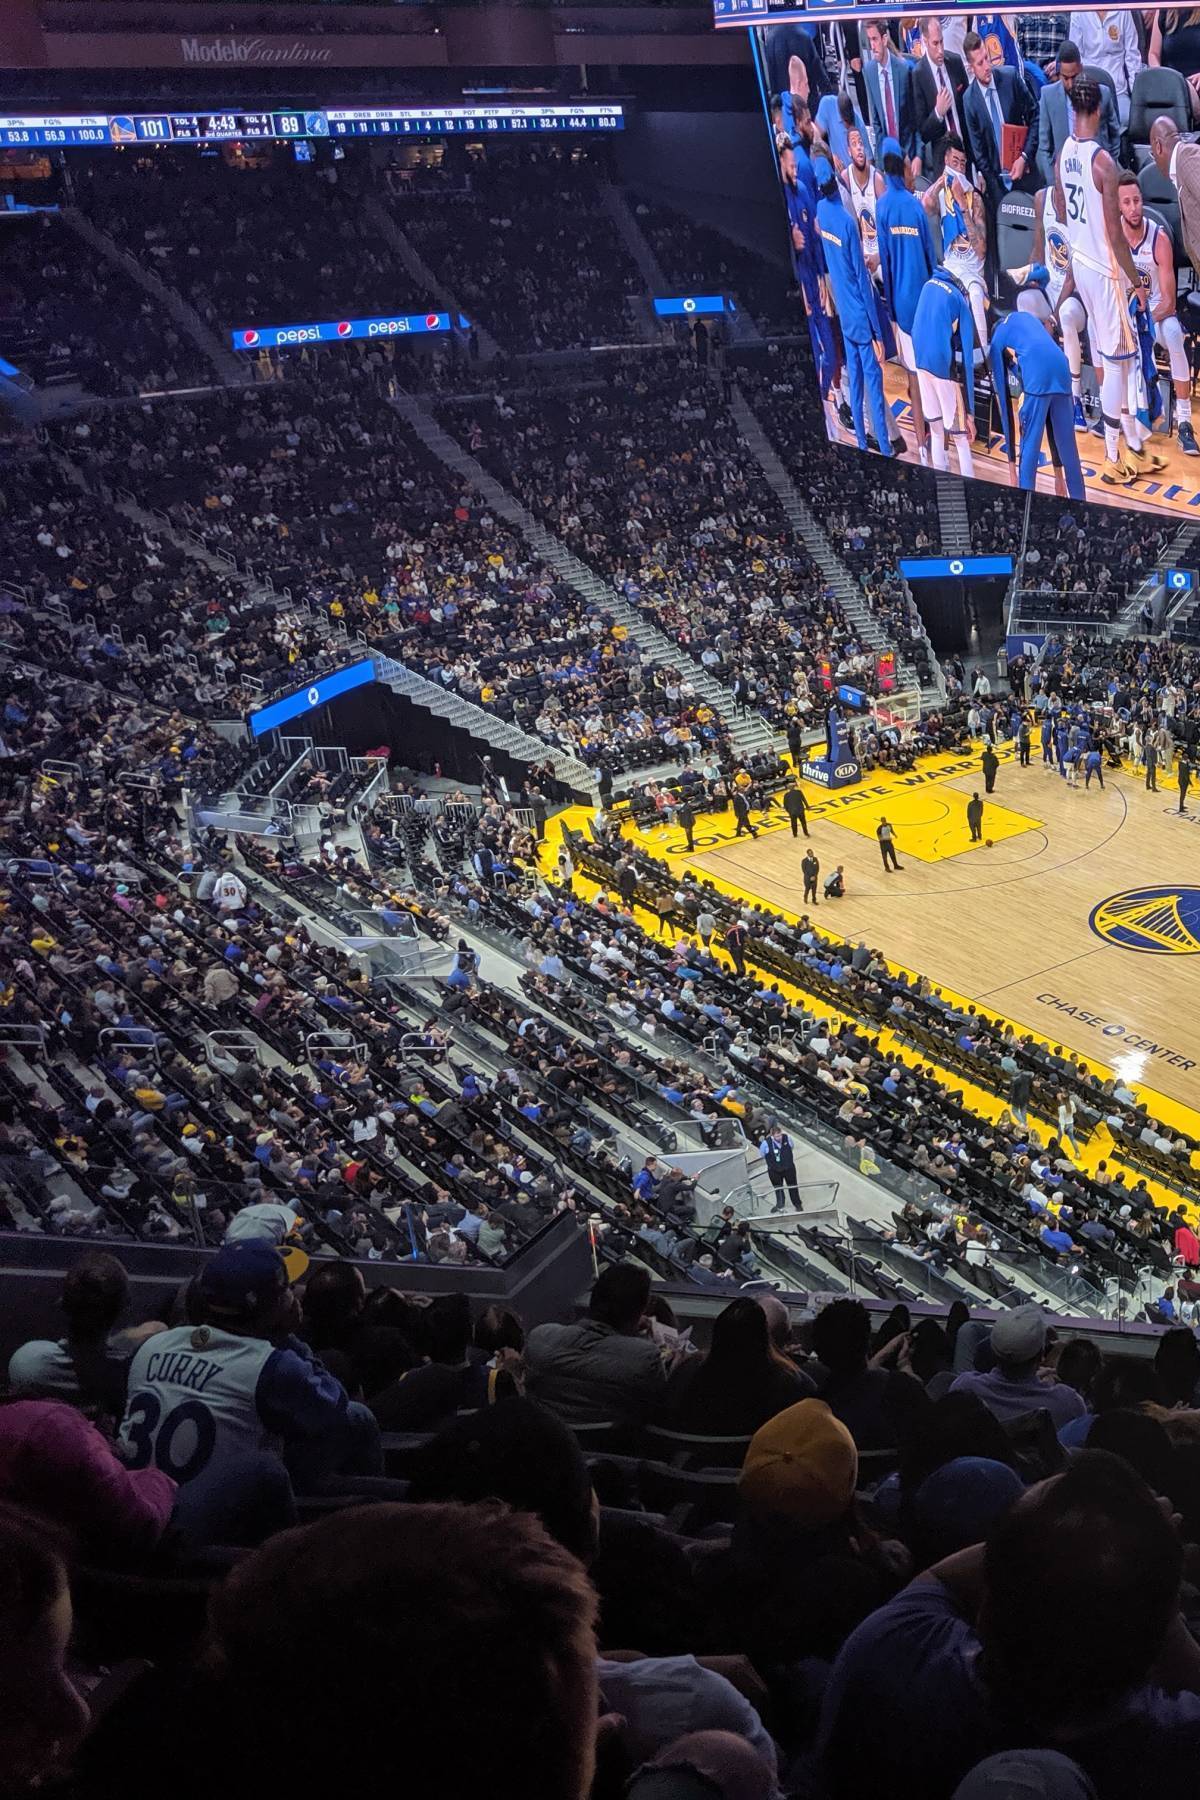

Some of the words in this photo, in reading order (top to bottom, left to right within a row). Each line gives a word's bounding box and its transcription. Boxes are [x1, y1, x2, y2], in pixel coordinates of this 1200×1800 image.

[181, 38, 250, 62] Modelo
[246, 38, 332, 61] Cantina
[140, 120, 164, 138] 101
[174, 117, 191, 125] TOL
[208, 115, 236, 131] 4:43
[244, 116, 260, 124] TOL
[281, 116, 299, 133] 89
[445, 120, 454, 130] 12
[511, 119, 527, 129] 57.1
[540, 118, 558, 128] 32.4
[570, 118, 587, 128] 44.4
[8, 131, 29, 142] 53.8
[44, 130, 66, 141] 56.9
[78, 129, 104, 141] 100.0
[1064, 183, 1087, 225] 32
[276, 325, 320, 346] pepsi
[368, 317, 411, 337] pepsi
[801, 762, 829, 783] thrive
[806, 785, 893, 814] STATE
[223, 887, 236, 897] 30
[1036, 992, 1107, 1029] CHASE
[1123, 1033, 1197, 1072] CENTER
[146, 1352, 223, 1391] CURRY
[118, 1391, 216, 1485] 30
